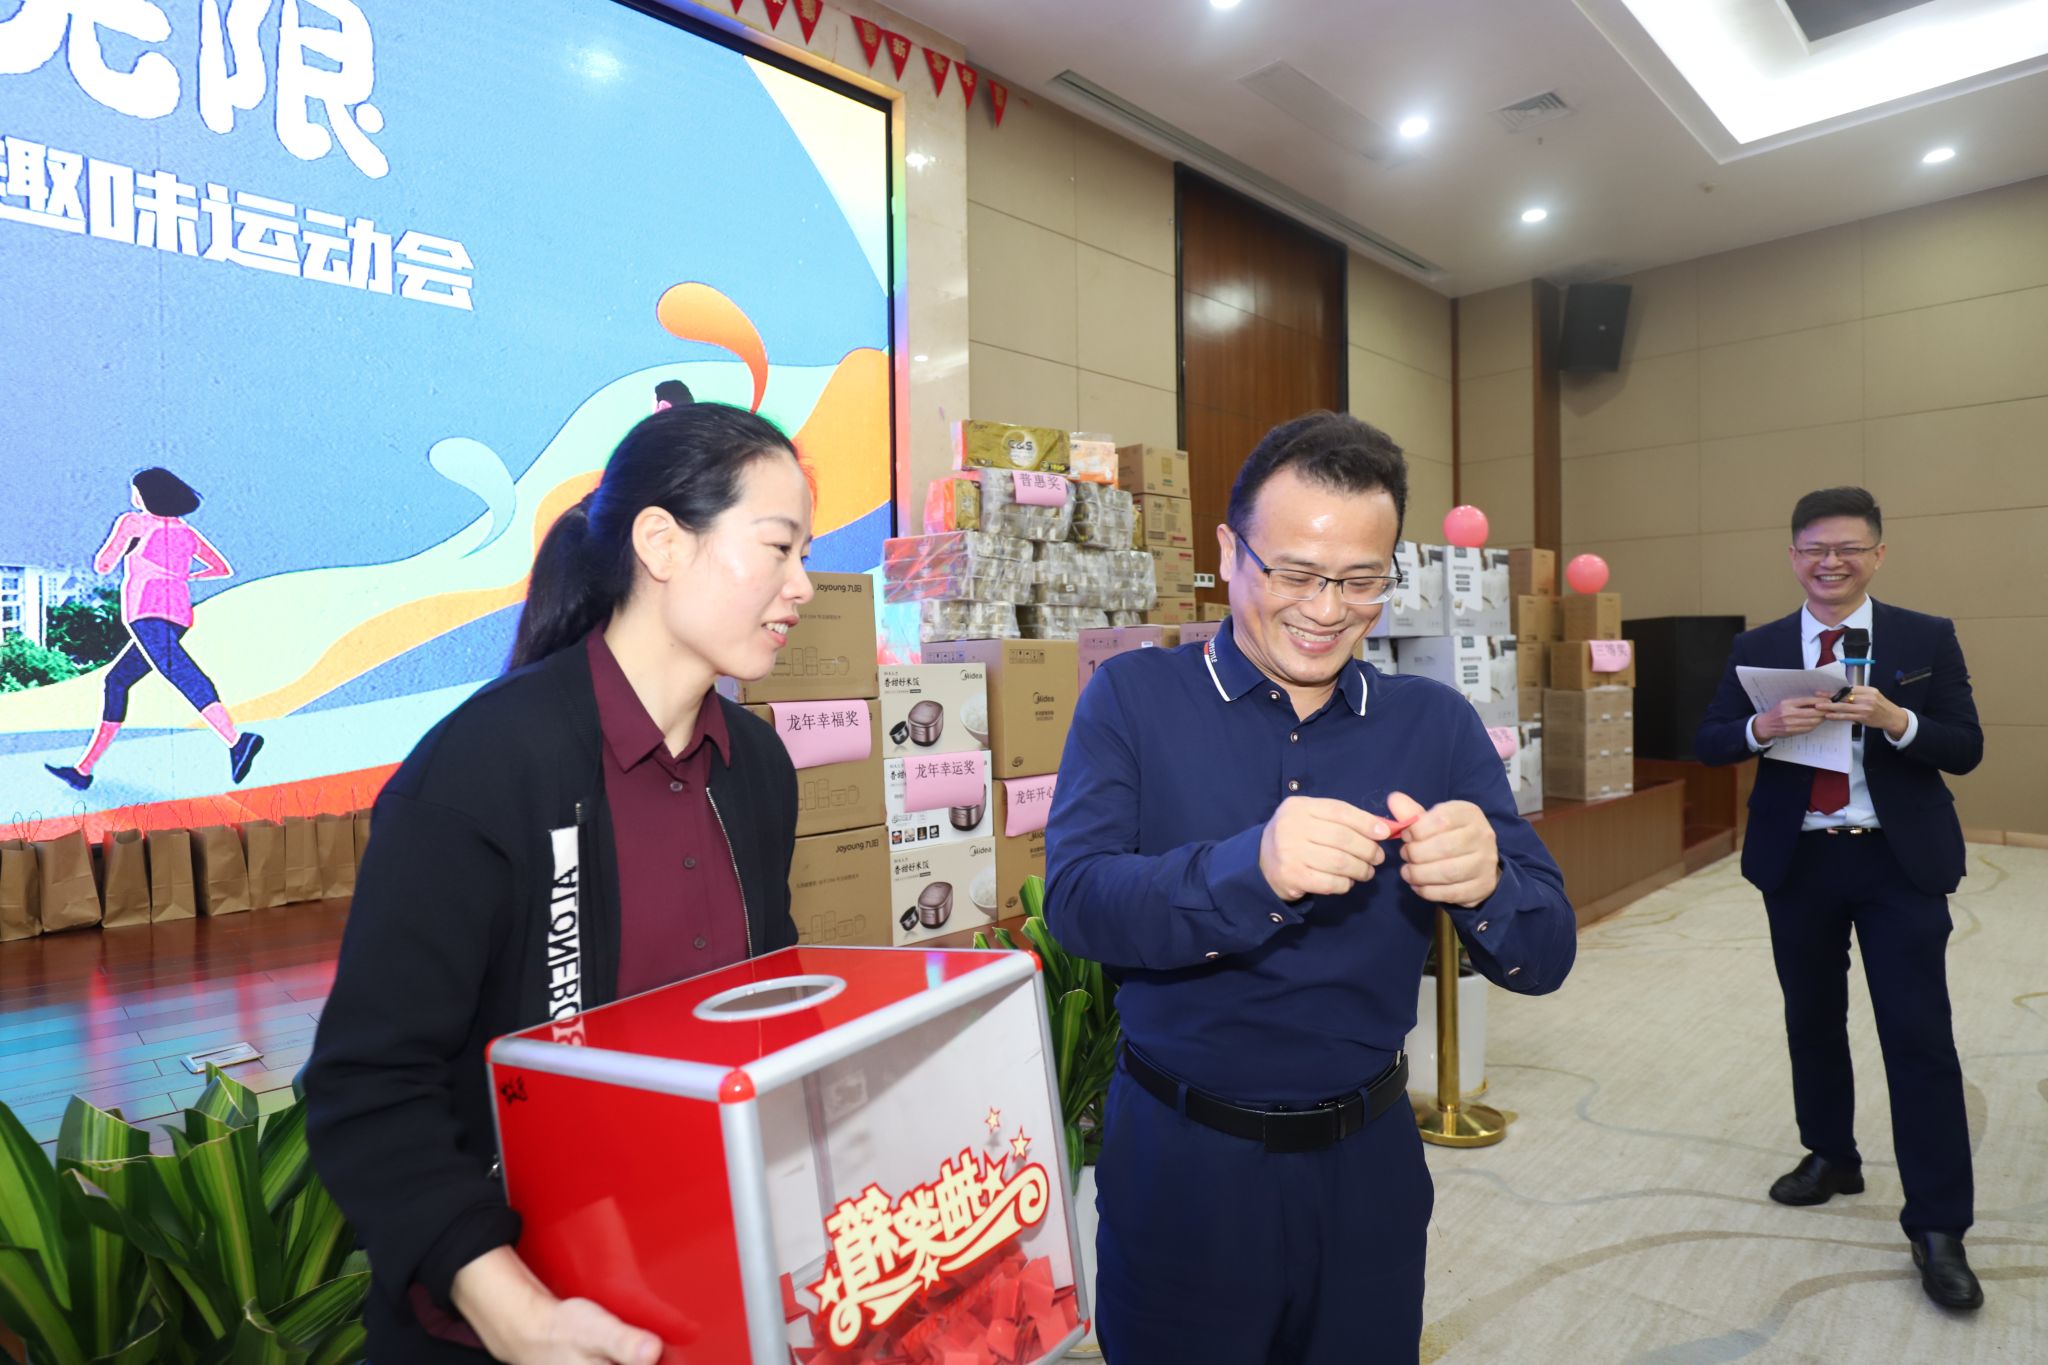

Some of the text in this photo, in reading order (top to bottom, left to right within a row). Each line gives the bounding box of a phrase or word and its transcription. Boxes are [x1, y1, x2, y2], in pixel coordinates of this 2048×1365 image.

[0, 134, 475, 312] 趣味运动会
[1007, 439, 1034, 451] C&S
[1019, 472, 1062, 491] 普惠奖
[816, 584, 847, 592] Joyoung
[960, 669, 983, 681] Midea
[1033, 691, 1055, 704] Midea
[786, 709, 860, 732] 龙年幸福奖
[914, 759, 976, 779] 龙年幸运奖
[835, 842, 864, 853] Joyoung
[969, 845, 992, 857] Midea
